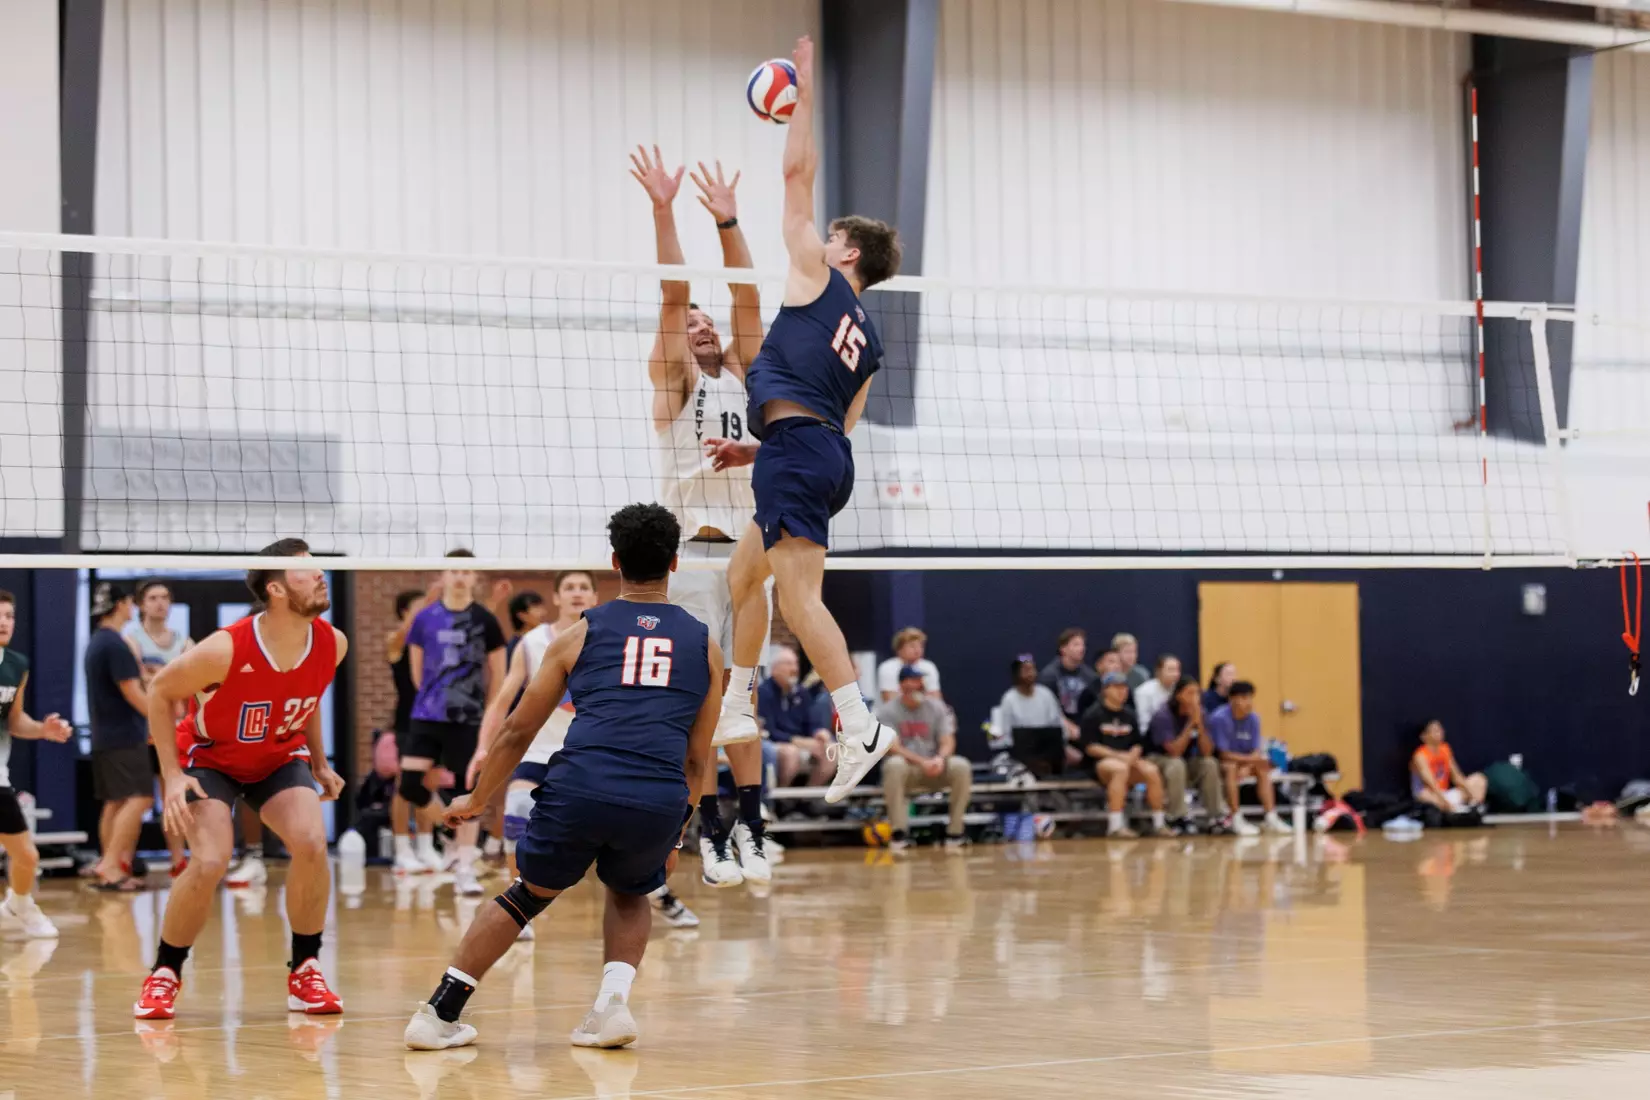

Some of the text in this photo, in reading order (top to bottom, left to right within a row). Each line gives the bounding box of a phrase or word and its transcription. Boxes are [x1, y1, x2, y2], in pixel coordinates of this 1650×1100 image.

[831, 313, 867, 372] 15
[720, 411, 742, 441] 19
[621, 636, 672, 686] 16
